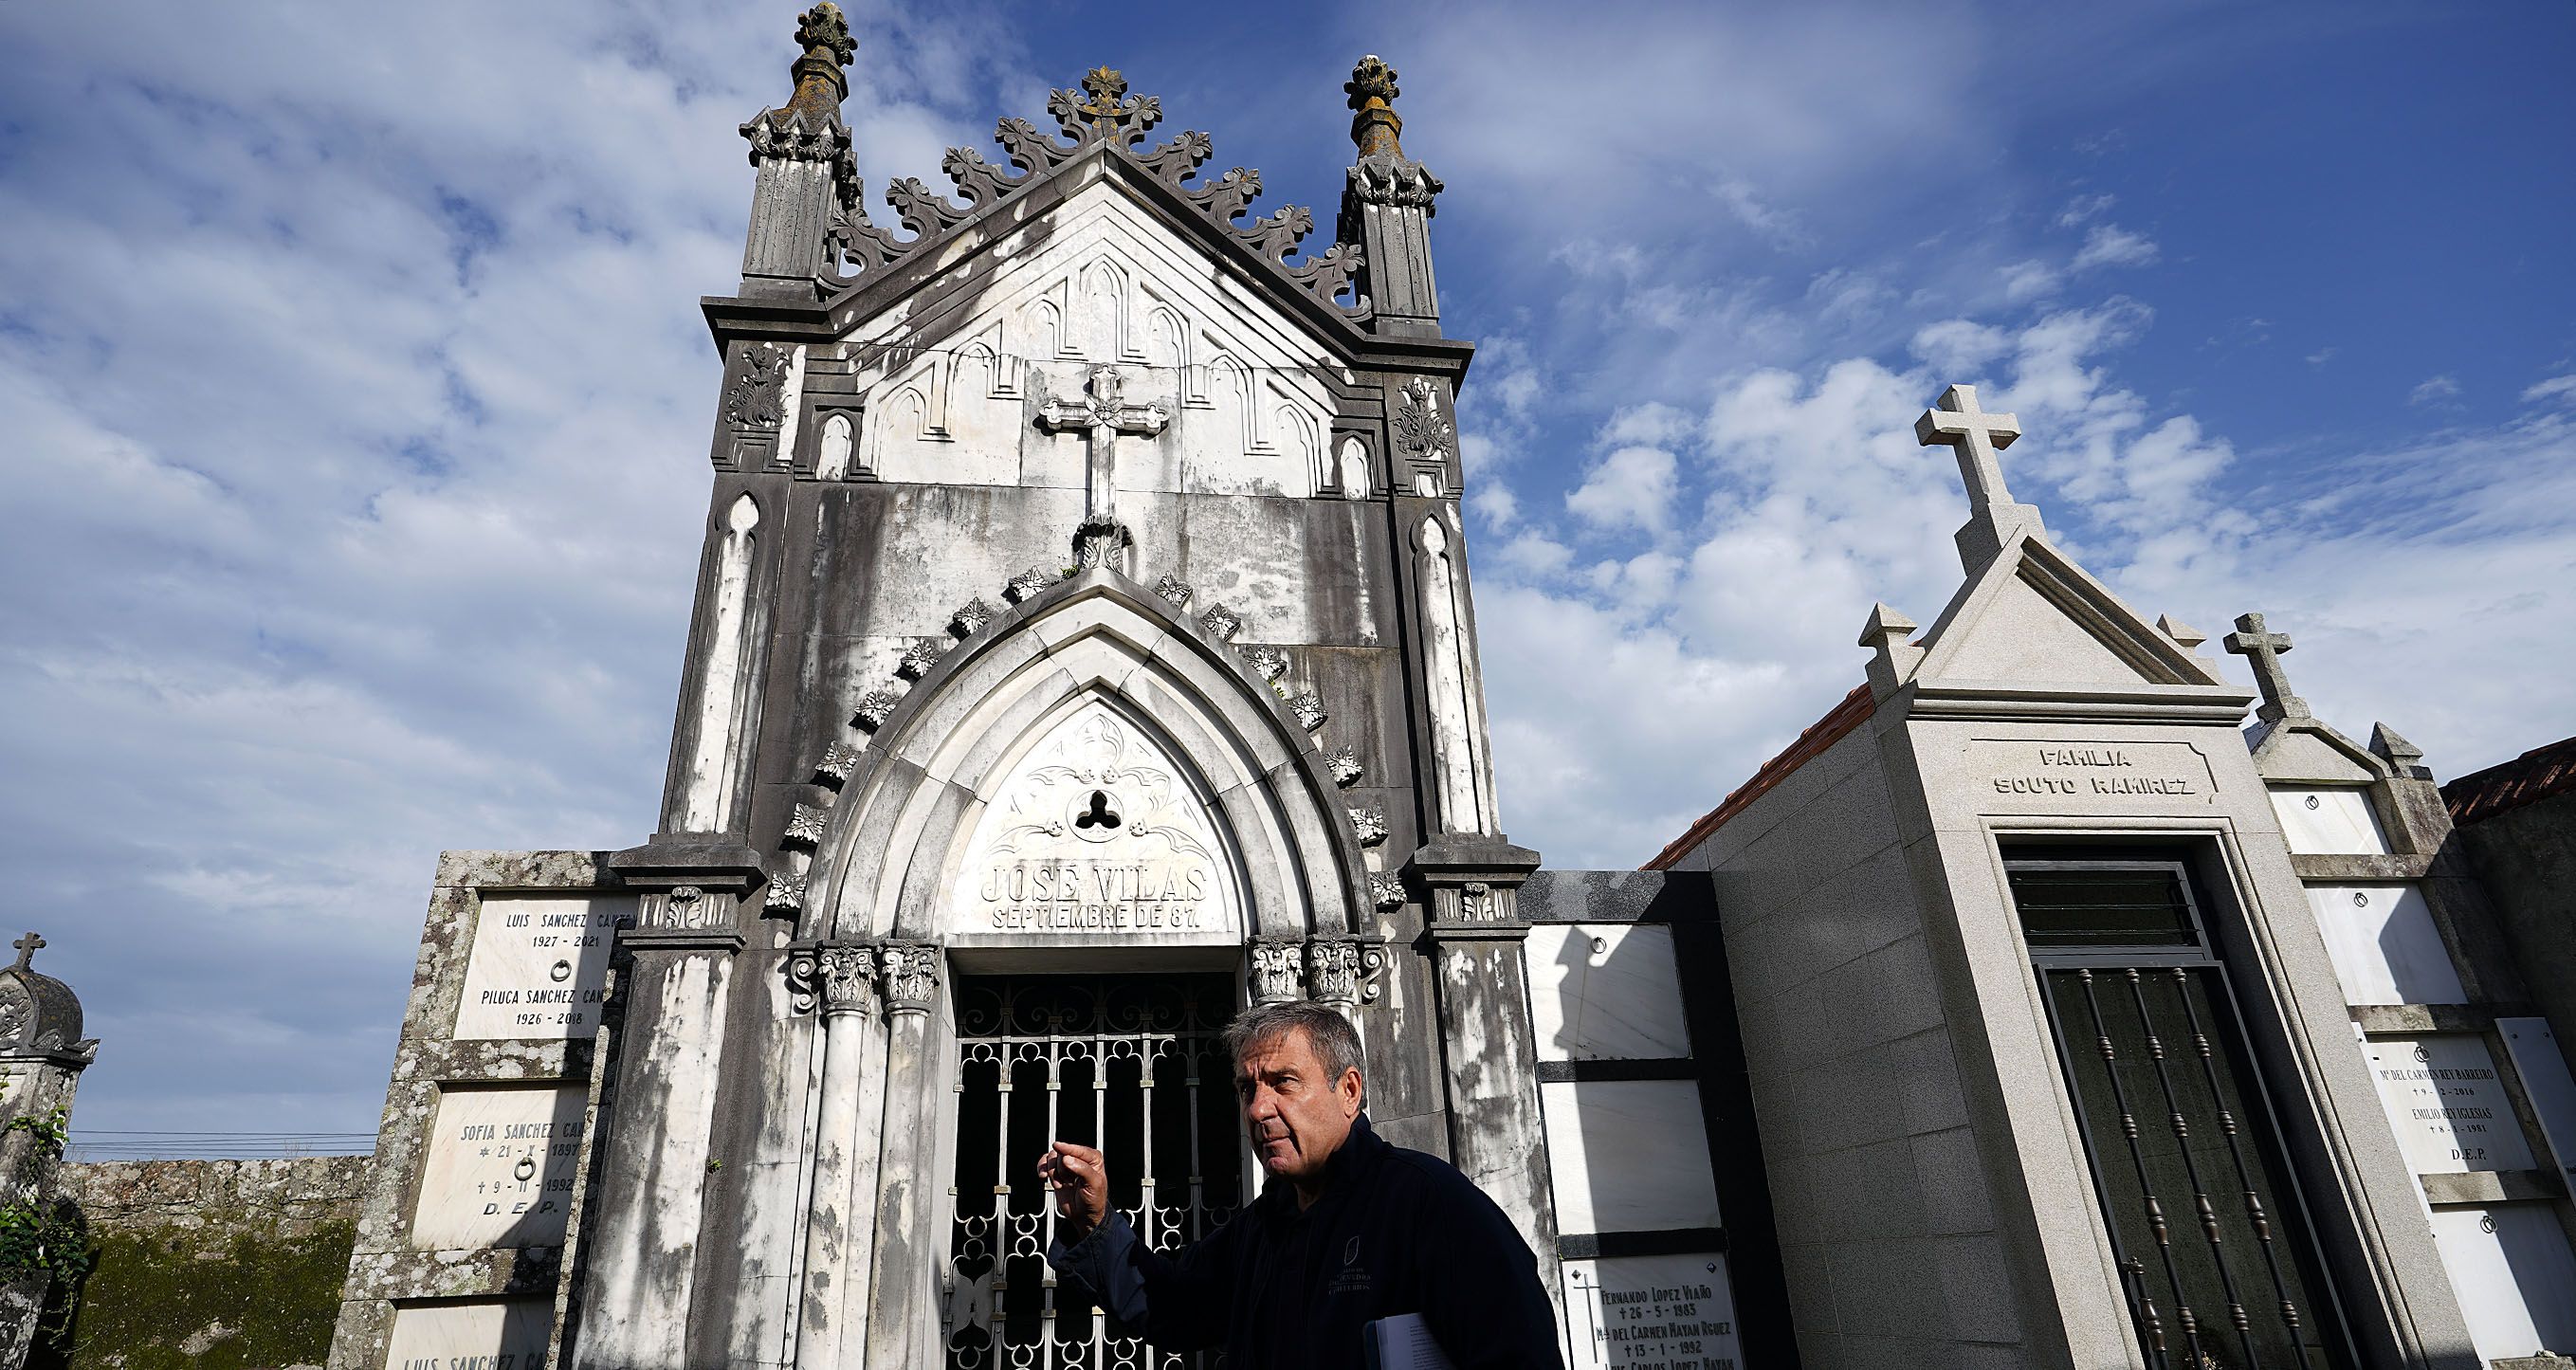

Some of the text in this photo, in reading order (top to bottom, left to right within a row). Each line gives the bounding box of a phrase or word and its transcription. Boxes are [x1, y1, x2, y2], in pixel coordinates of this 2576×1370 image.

[2039, 749, 2132, 767] FAMILIA
[1993, 777, 2196, 795] SOUTO RAMIREZ
[1093, 865, 1207, 902] VILAS
[506, 914, 530, 928] LUIS
[540, 914, 586, 927] SANCHEZ
[993, 905, 1127, 928] SEPTIEMBRE
[1135, 905, 1163, 927] DE
[533, 936, 558, 947] 1927
[574, 936, 599, 947] 2021
[481, 990, 519, 1005] PILUCA
[525, 990, 575, 1004] SANCHEZ
[516, 1014, 541, 1025] 1926
[557, 1013, 583, 1025] 2018
[2390, 1069, 2407, 1081] DEL
[2407, 1069, 2439, 1081] CARMEN
[2439, 1069, 2455, 1080] REY
[2457, 1069, 2494, 1080] BARREIRO
[2455, 1087, 2475, 1096] 2016
[2411, 1107, 2493, 1120] EMILIO REY IGLESIAS
[461, 1125, 495, 1141] SOFIA
[504, 1123, 555, 1138] SANCHEZ
[2467, 1124, 2487, 1133] 1981
[498, 1145, 511, 1158] 21
[552, 1143, 580, 1156] 1897
[493, 1181, 501, 1194] 9
[546, 1178, 575, 1191] 1992
[1600, 1288, 1648, 1306] FERNANDO
[1652, 1287, 1681, 1303] LOPEZ
[1629, 1306, 1642, 1320] 26
[1612, 1328, 1630, 1341] DEL
[1631, 1324, 1668, 1340] CARMEN
[450, 1355, 516, 1370] SANCHEZ
